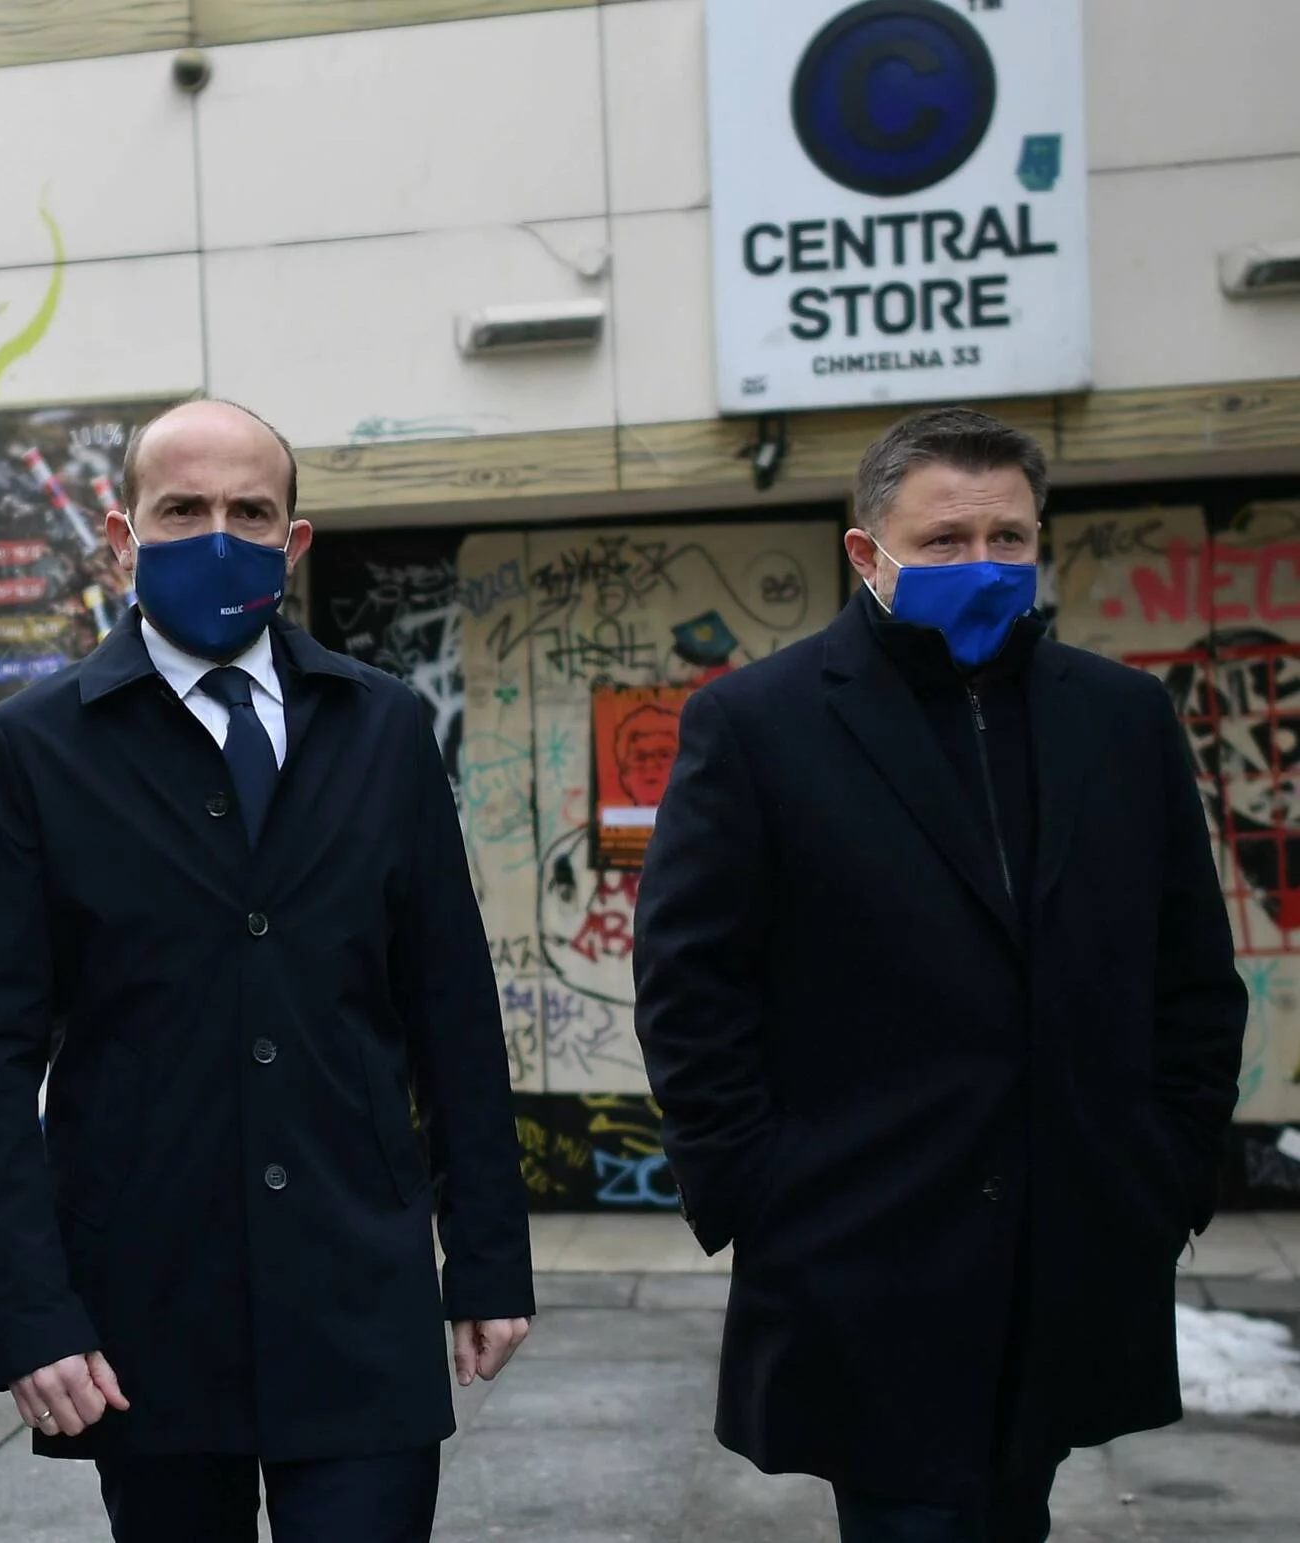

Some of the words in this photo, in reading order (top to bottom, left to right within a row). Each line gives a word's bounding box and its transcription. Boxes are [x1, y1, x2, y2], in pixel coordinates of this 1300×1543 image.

[742, 202, 1058, 277] CENTRAL
[789, 274, 1010, 341] STORE
[812, 347, 943, 376] CHMIELNA
[952, 345, 981, 367] 33
